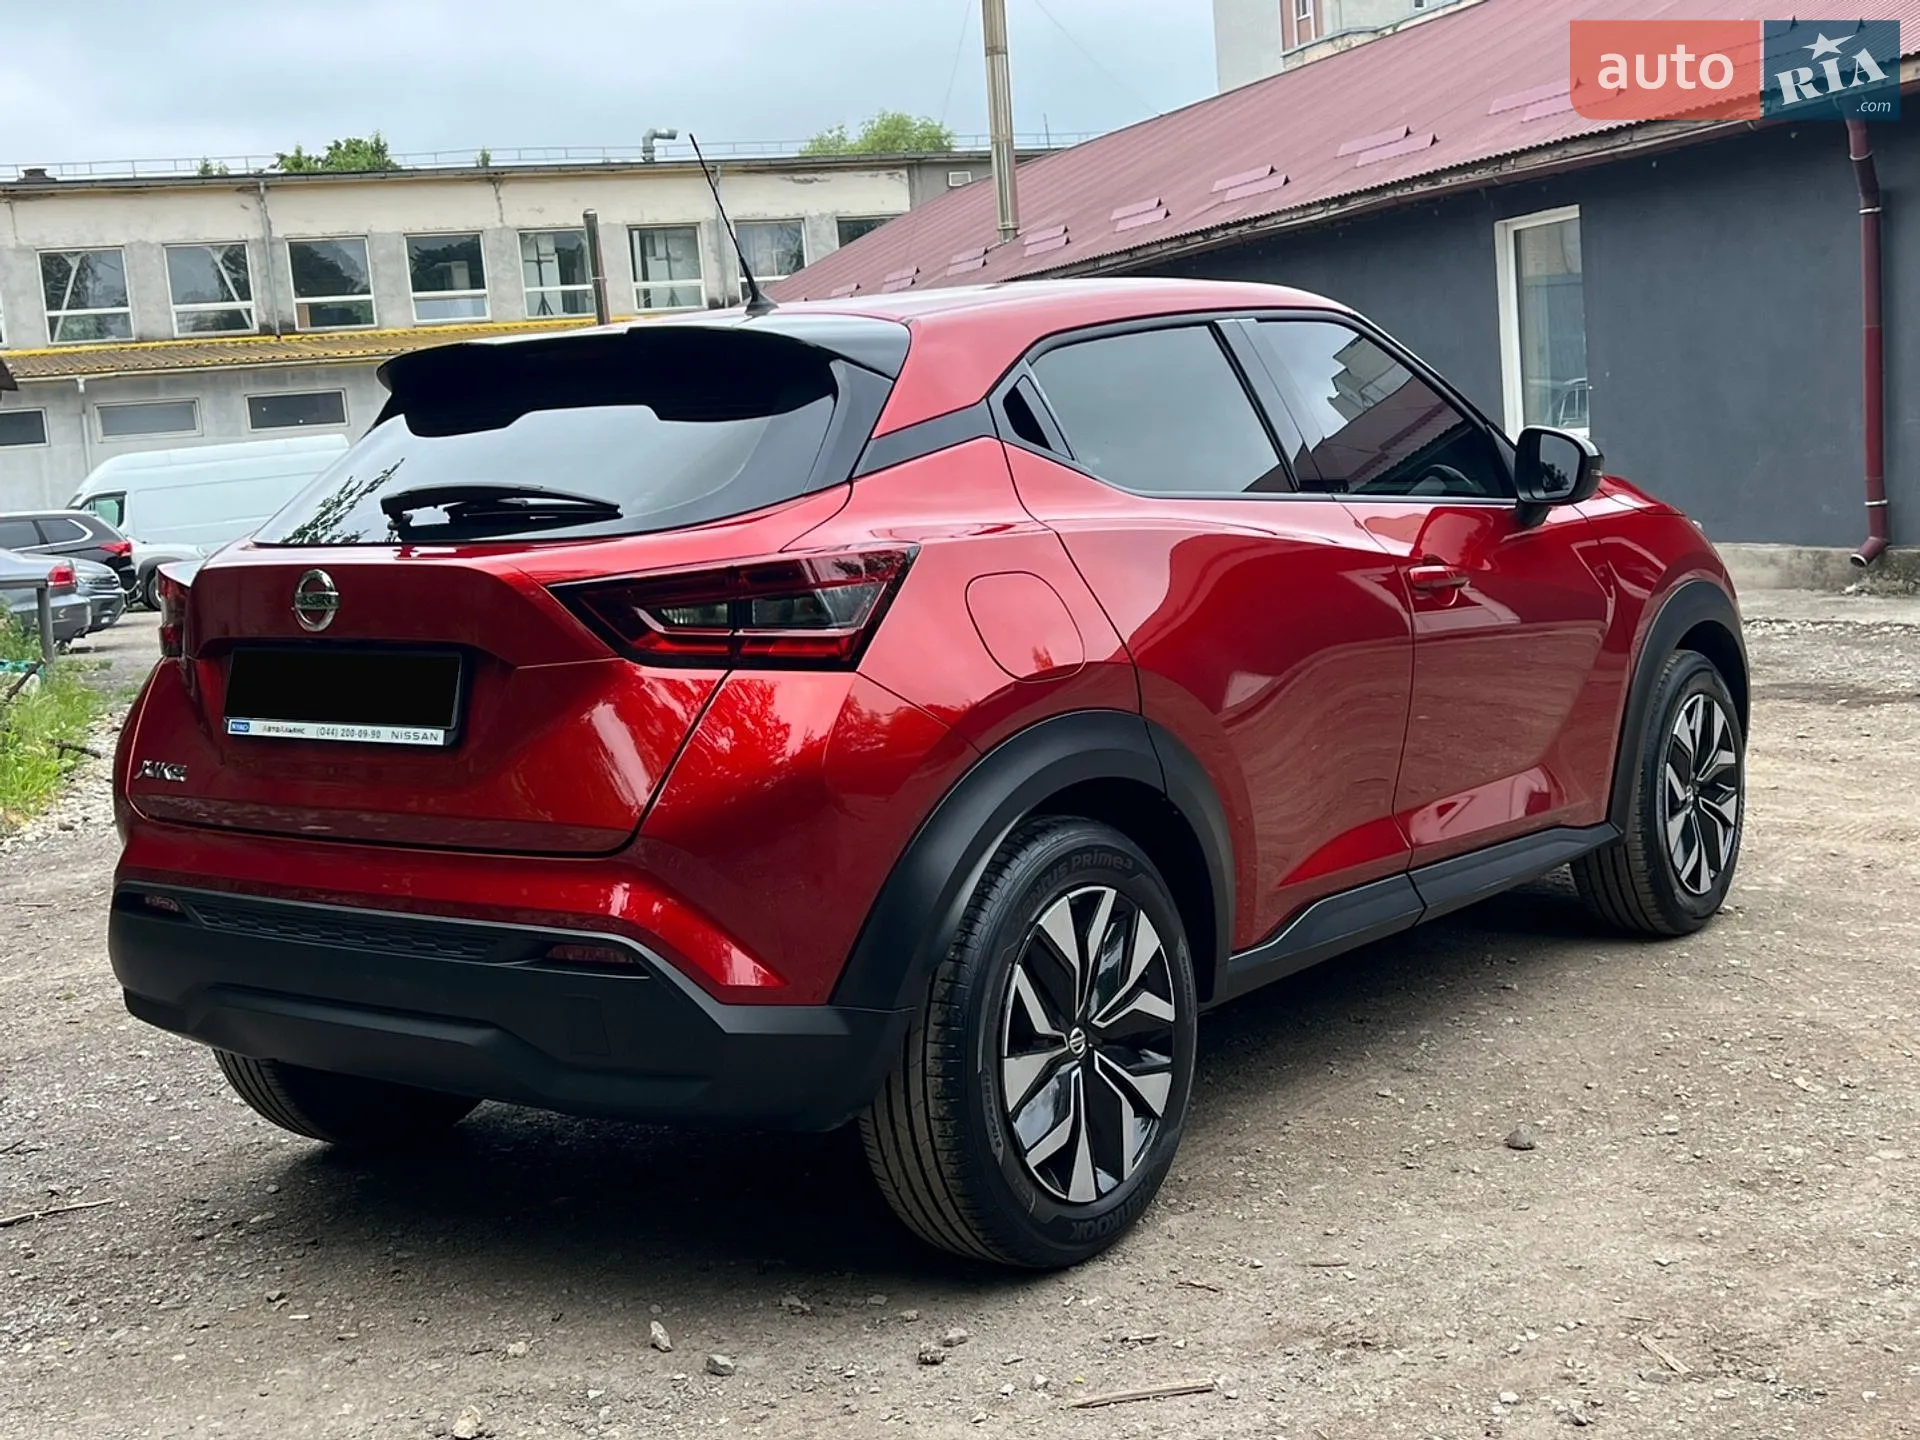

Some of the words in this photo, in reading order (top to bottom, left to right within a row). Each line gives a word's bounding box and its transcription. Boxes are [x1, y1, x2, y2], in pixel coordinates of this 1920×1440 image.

[316, 726, 338, 738] (044)
[341, 728, 381, 739] 200-09-90
[391, 730, 439, 742] NISSAN
